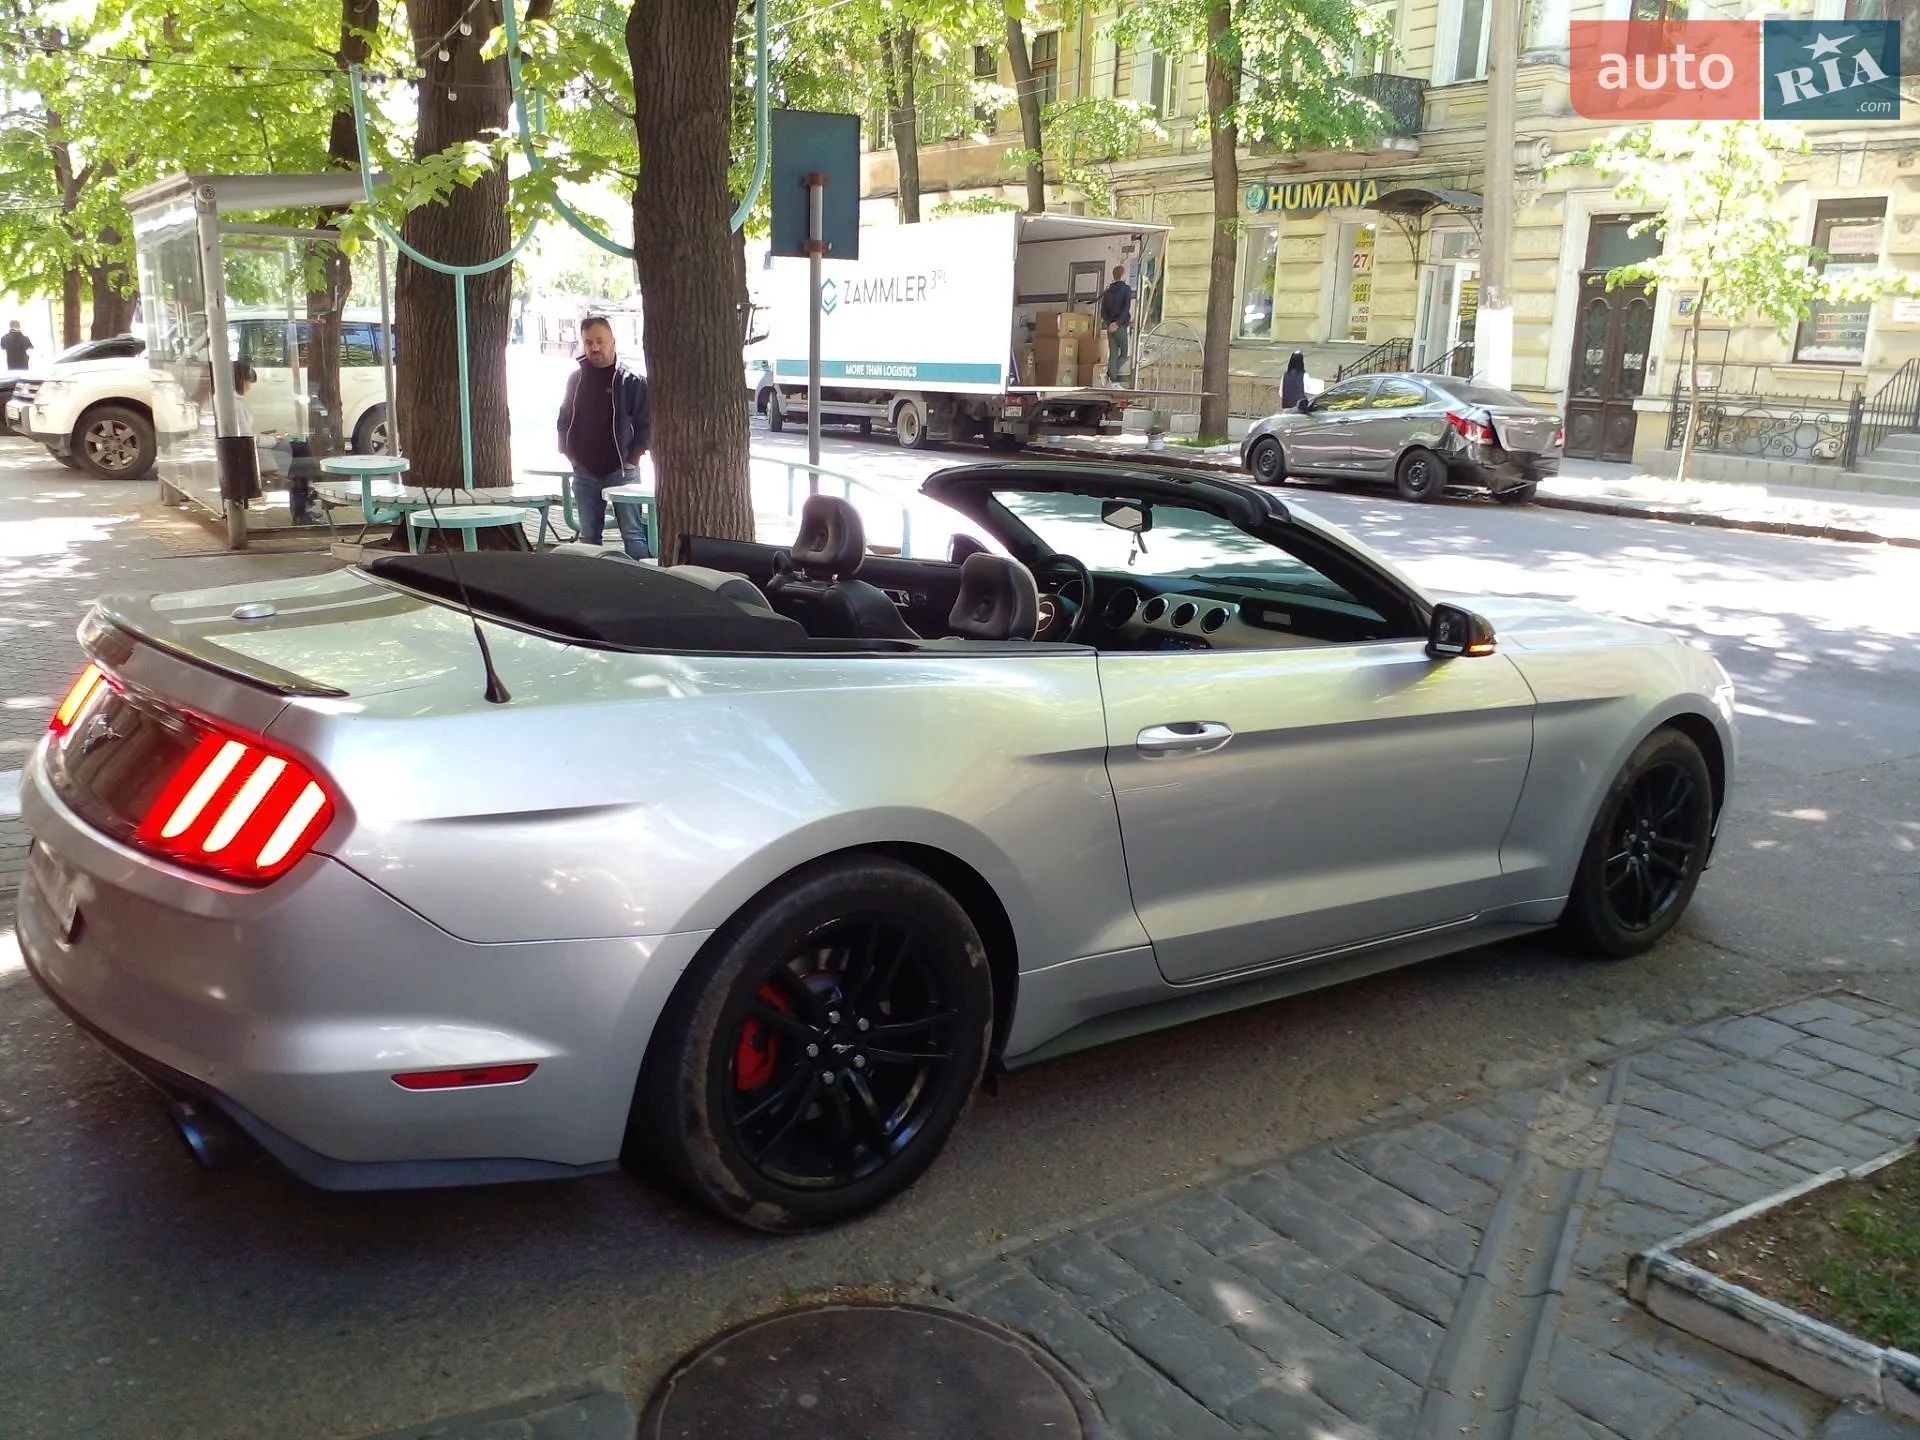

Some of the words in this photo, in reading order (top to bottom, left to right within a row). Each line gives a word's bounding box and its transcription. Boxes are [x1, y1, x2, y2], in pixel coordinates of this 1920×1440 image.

[1267, 180, 1379, 210] HUMANA
[844, 275, 927, 305] ZAMMLER
[845, 364, 865, 376] MORE
[866, 364, 882, 376] THAN
[883, 365, 917, 377] LOGISTICS
